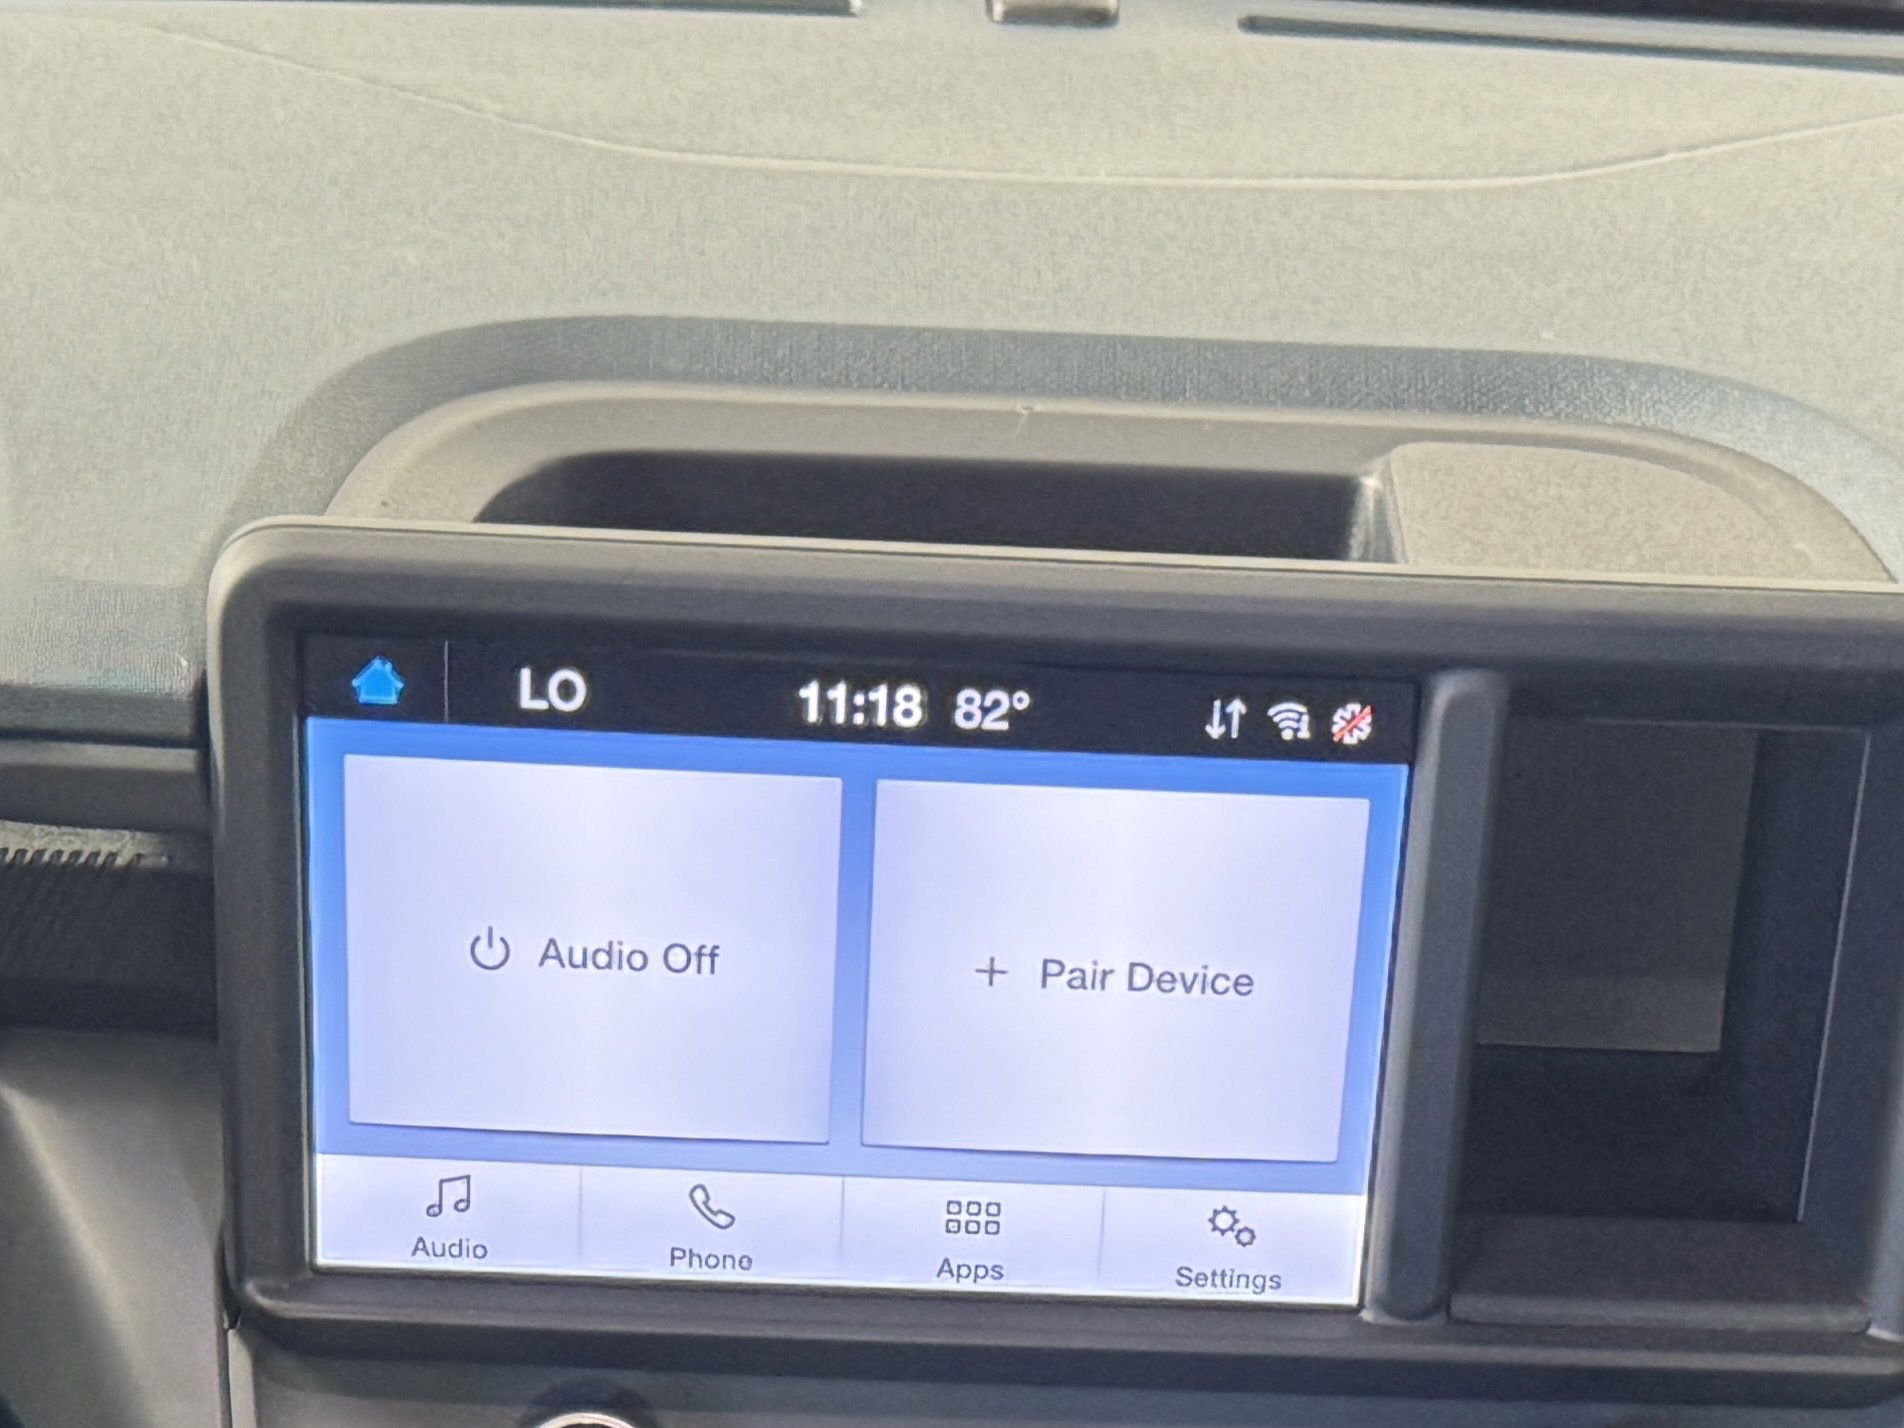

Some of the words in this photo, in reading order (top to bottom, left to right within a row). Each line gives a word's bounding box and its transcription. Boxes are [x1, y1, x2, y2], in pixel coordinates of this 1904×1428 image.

[519, 667, 586, 712] LO
[798, 680, 924, 728] 11:18
[954, 688, 1031, 731] 82°
[537, 937, 649, 973] Audio
[661, 941, 721, 976] Off
[1039, 958, 1115, 994] Pair
[1126, 962, 1255, 998] Device
[412, 1235, 489, 1263] Audio
[669, 1245, 754, 1274] Phone
[936, 1256, 1005, 1284] Apps
[1175, 1264, 1282, 1294] Settings
